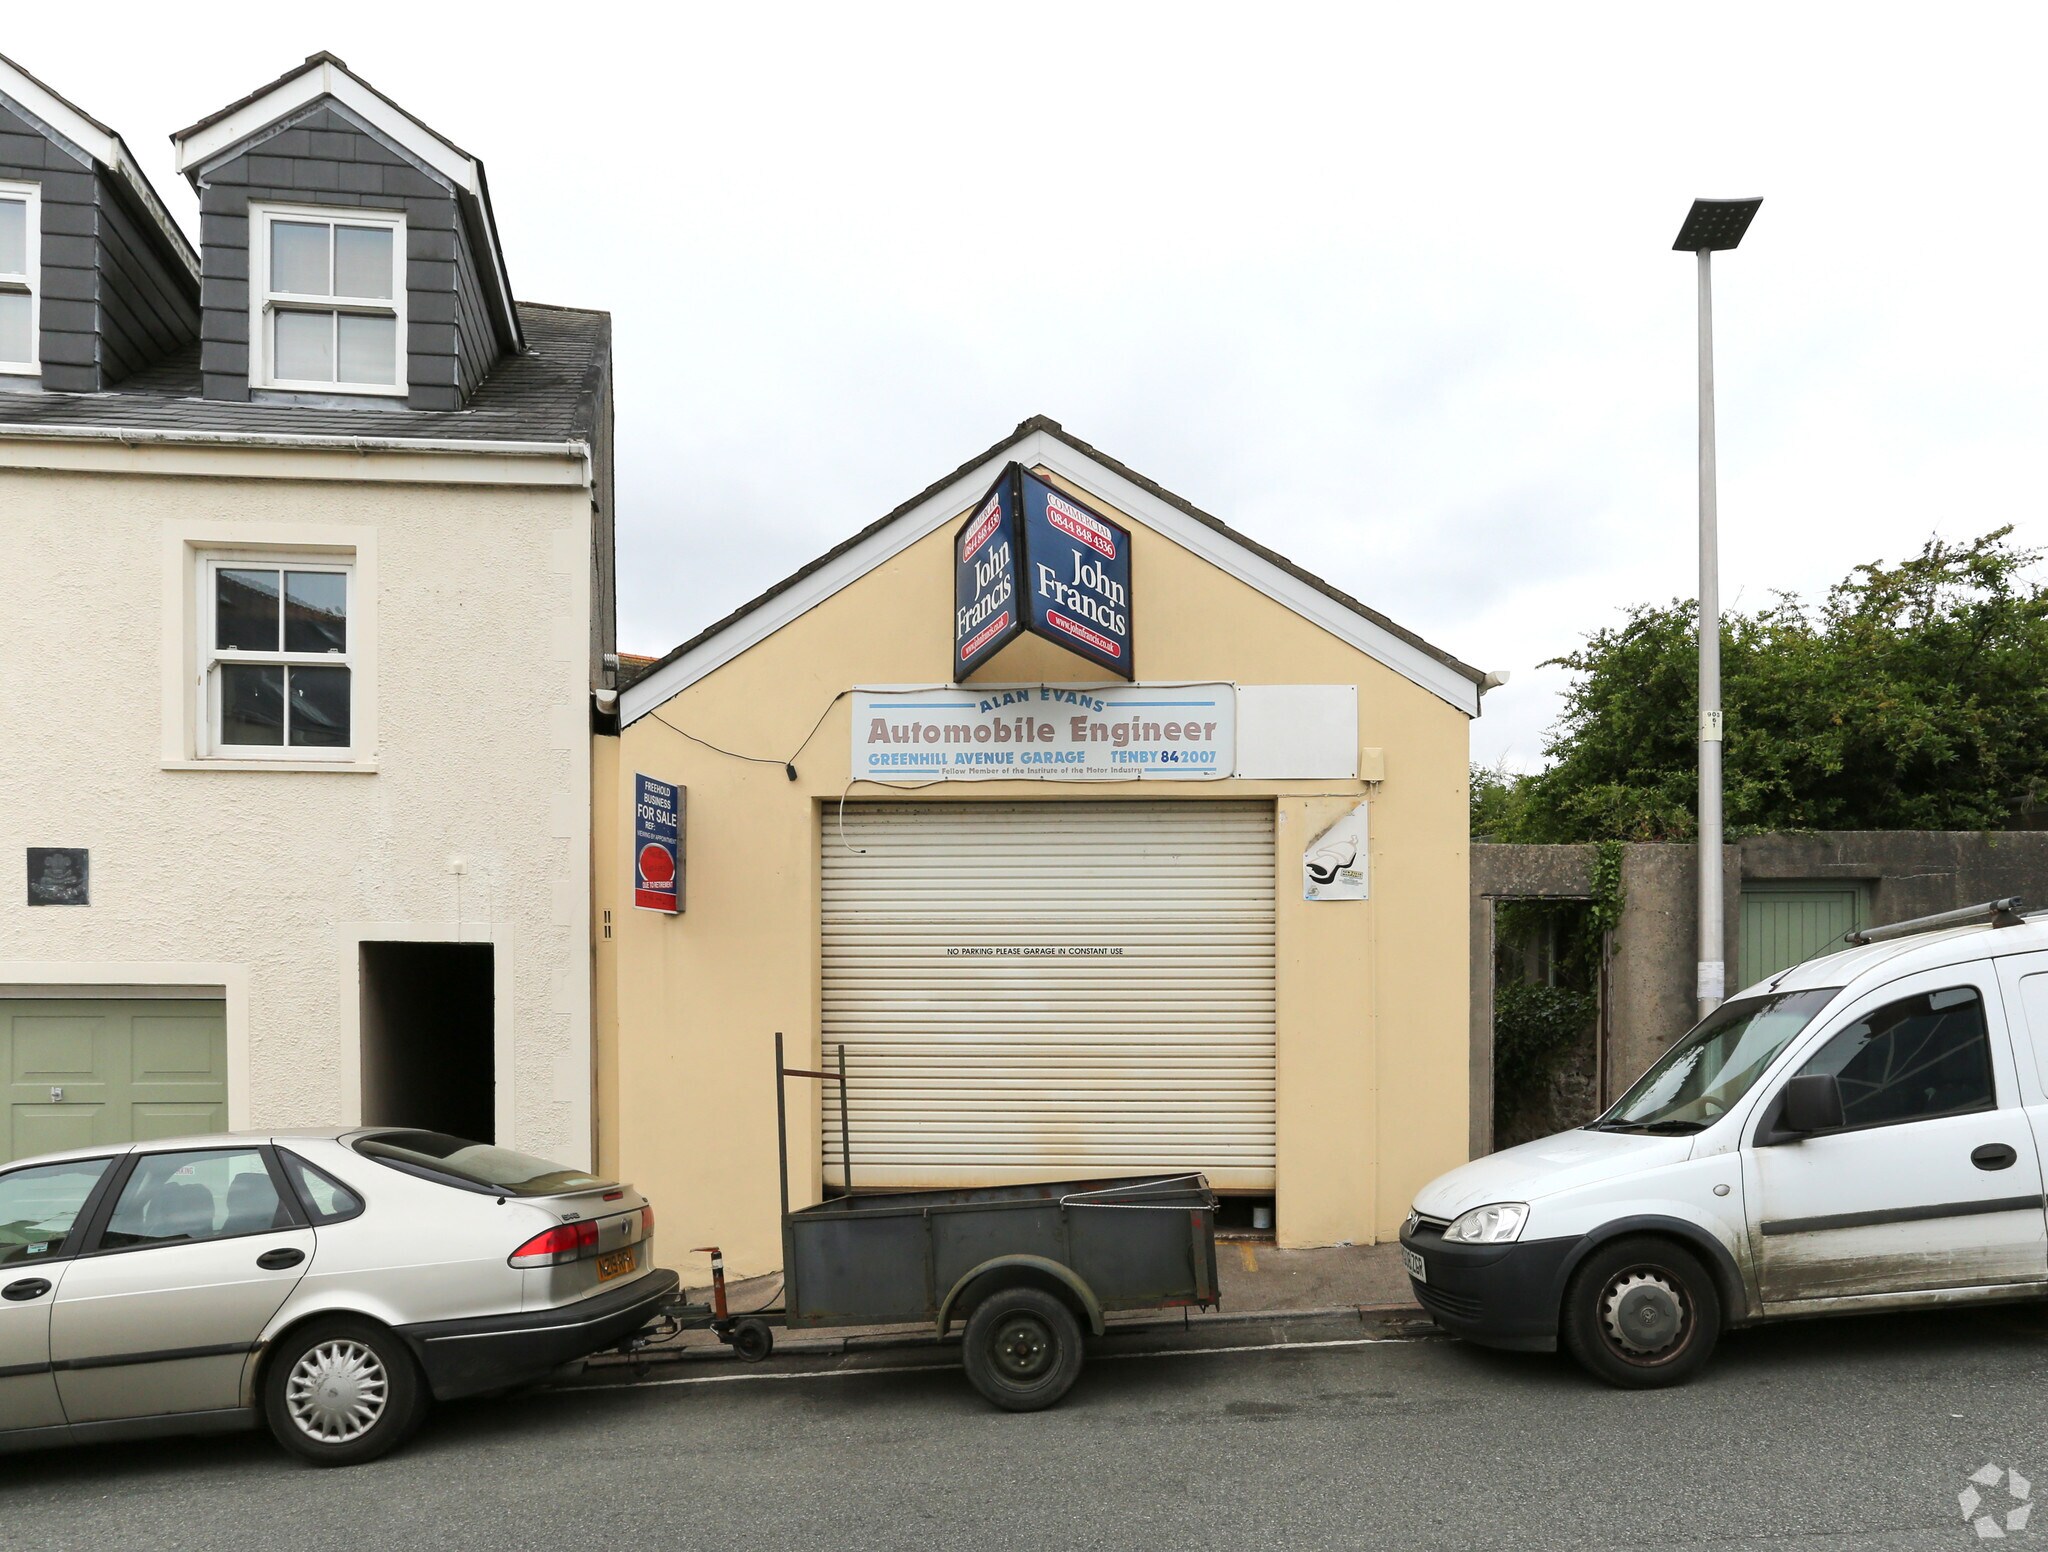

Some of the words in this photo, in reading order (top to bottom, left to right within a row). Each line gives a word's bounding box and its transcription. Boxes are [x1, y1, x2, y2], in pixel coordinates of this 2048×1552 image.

[1049, 494, 1111, 540] COMMERCIAL
[1051, 512, 1074, 533] 0844
[1075, 524, 1092, 542] 848
[1093, 535, 1112, 556] 4336
[975, 542, 1010, 601] John
[1072, 548, 1125, 607] John
[957, 573, 1011, 640] Francis
[1037, 562, 1125, 636] Francis
[1055, 616, 1114, 652] www.johnfrancis.co.uk
[979, 690, 1030, 713] ALAN
[1041, 687, 1106, 713] EVANS
[867, 717, 1056, 744] Automobile
[1070, 715, 1217, 747] Engineer
[868, 752, 948, 766] GREENHILL
[954, 752, 1014, 765] AVENUE
[1020, 750, 1086, 764] GARAGE
[1110, 750, 1158, 764] TENBY
[1110, 767, 1142, 775] Industry
[644, 781, 670, 797] FREEHOLD
[644, 793, 671, 810] BUSINESS
[638, 804, 654, 821] FOR
[656, 809, 676, 827] SALE
